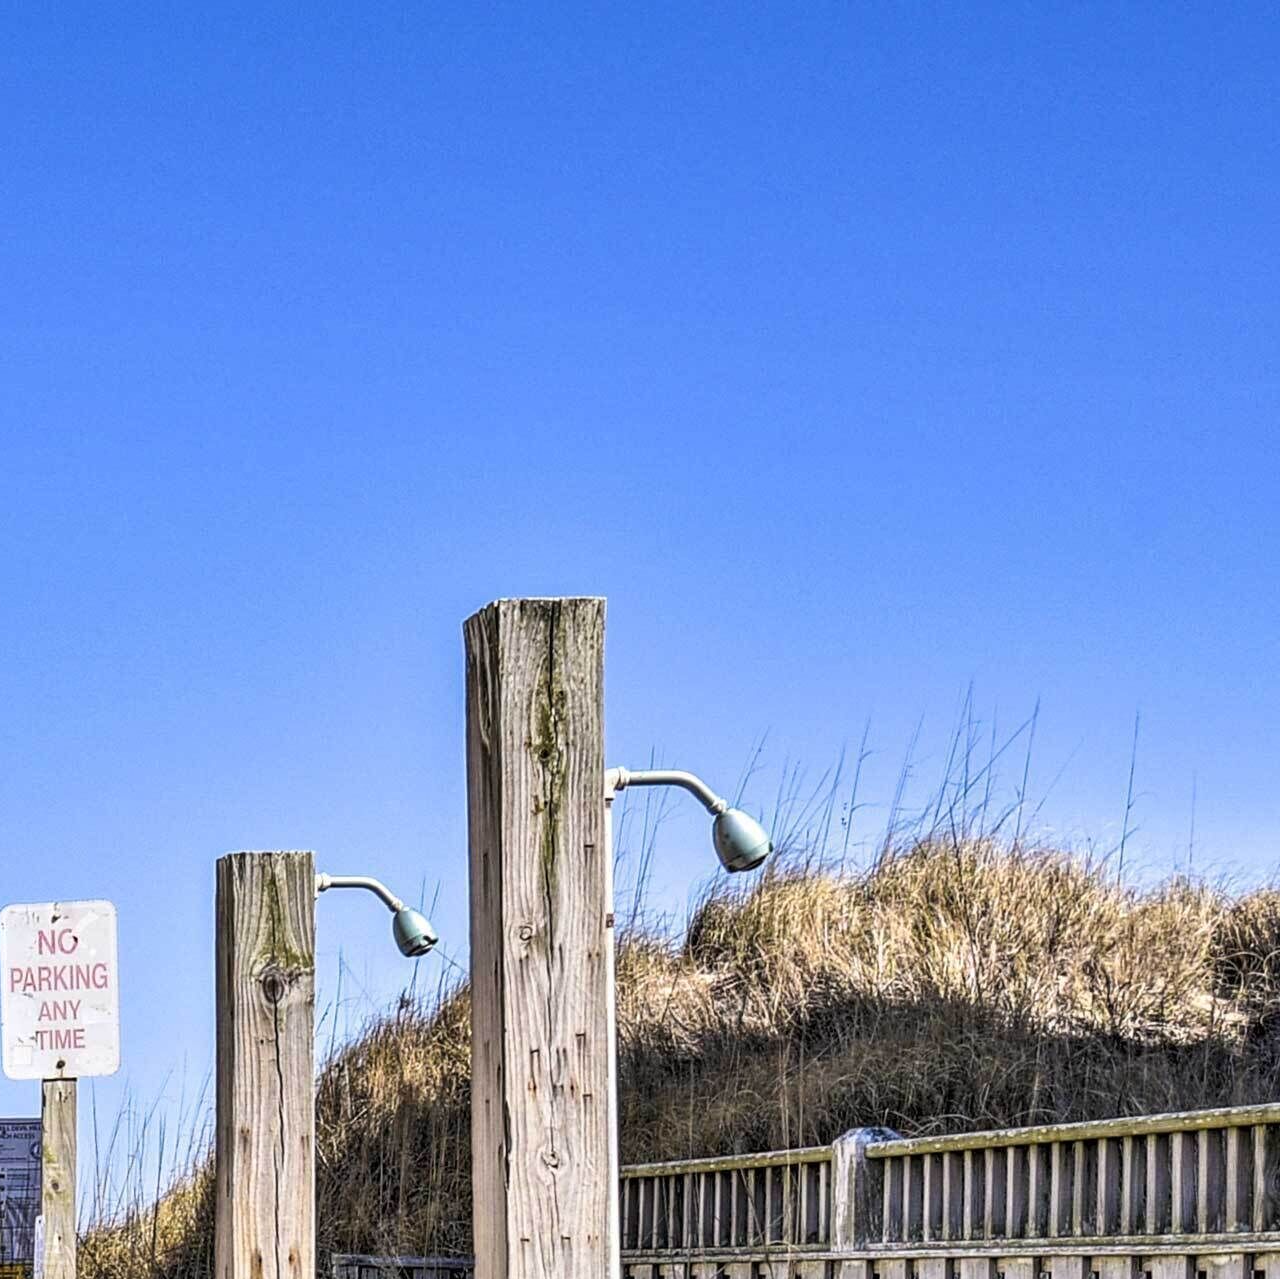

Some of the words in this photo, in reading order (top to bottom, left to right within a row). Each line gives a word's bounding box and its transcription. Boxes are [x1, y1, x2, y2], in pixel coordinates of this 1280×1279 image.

[37, 928, 79, 955] NO
[9, 963, 109, 993] PARKING
[37, 1000, 82, 1022] ANY
[37, 1028, 86, 1051] TIME
